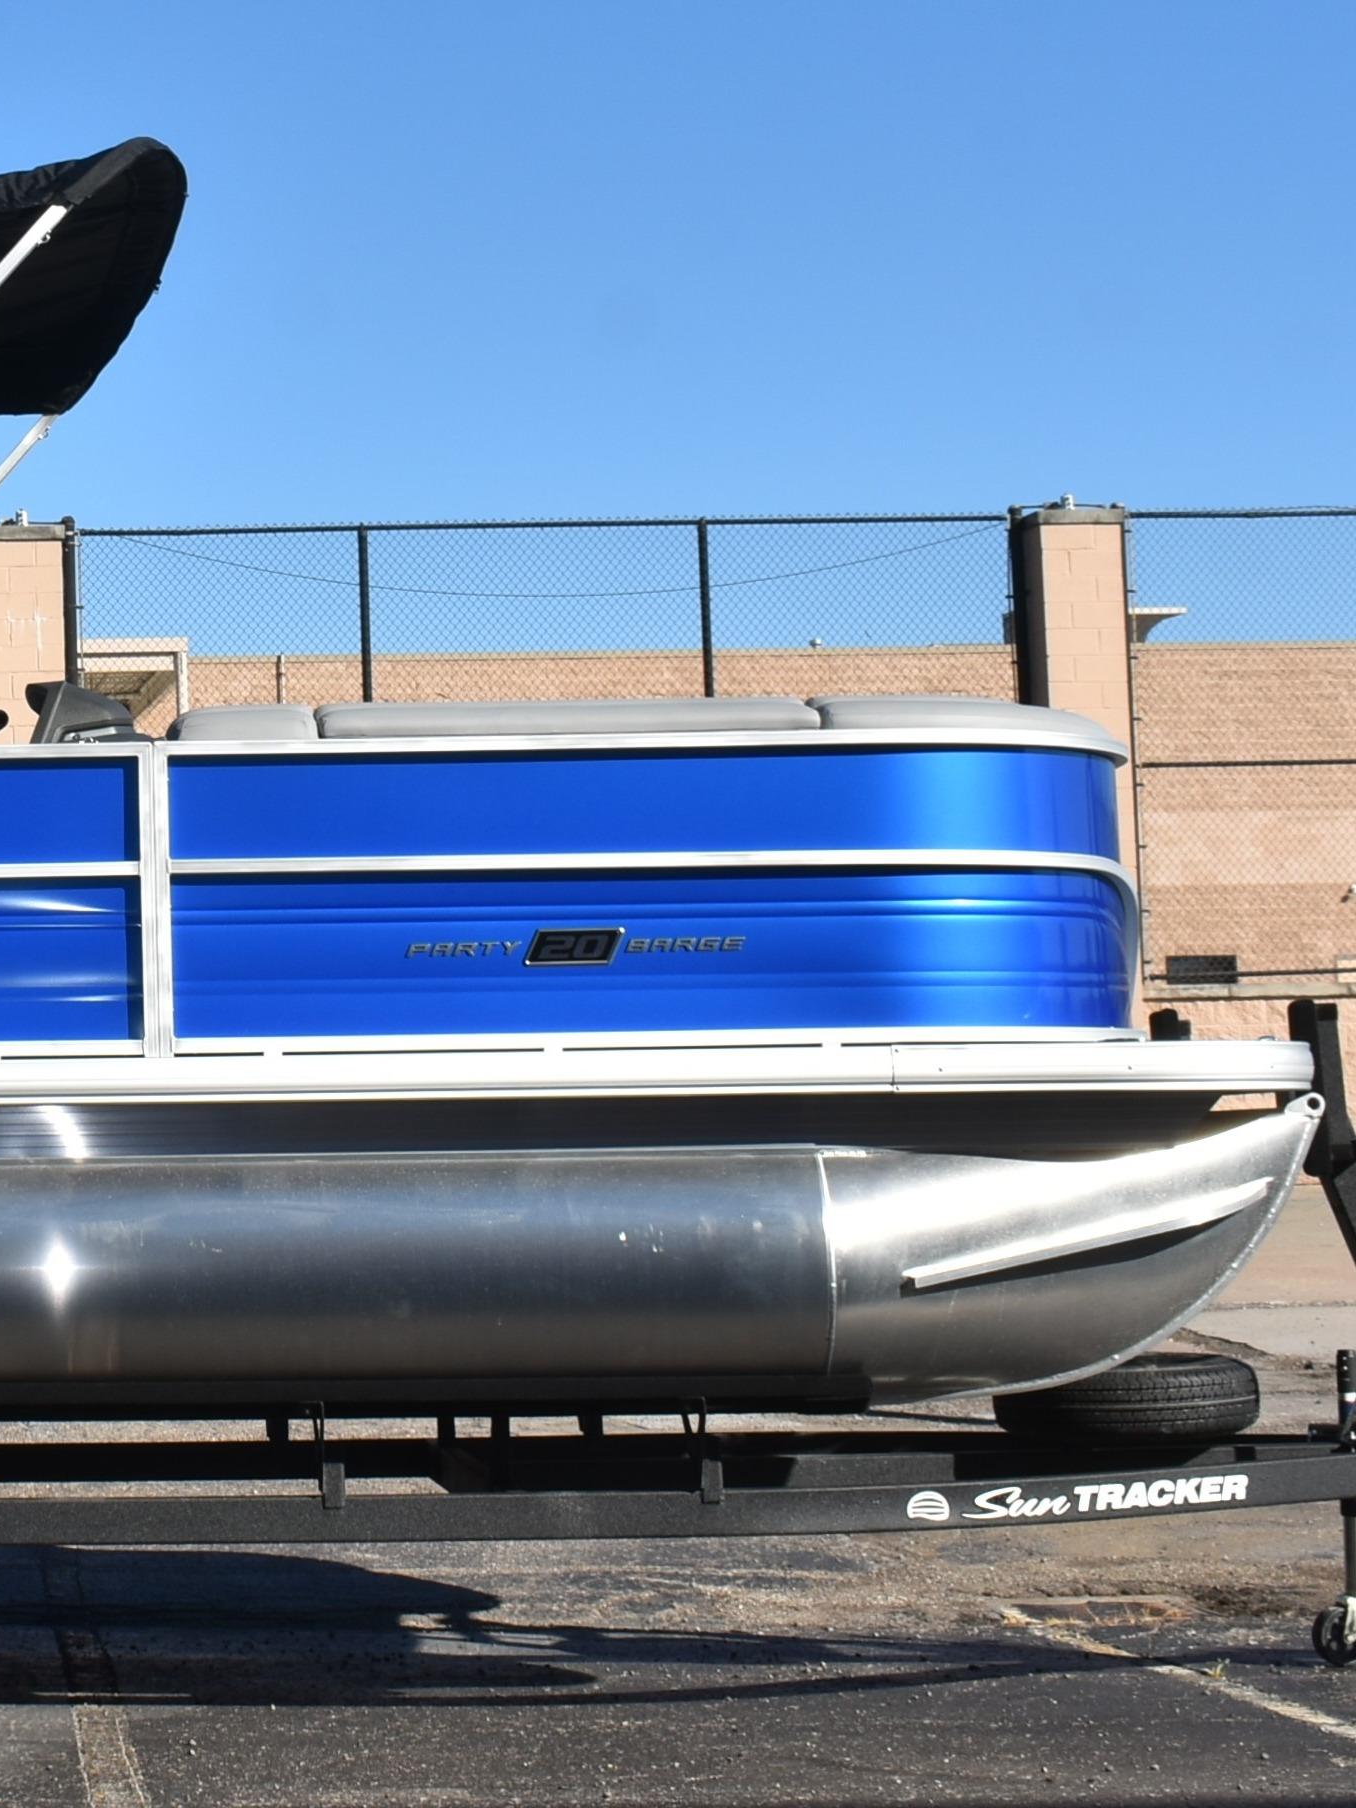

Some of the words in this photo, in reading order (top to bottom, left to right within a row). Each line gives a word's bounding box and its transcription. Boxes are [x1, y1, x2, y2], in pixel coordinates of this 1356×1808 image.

[405, 940, 522, 959] PARTY
[538, 934, 610, 961] 20
[624, 935, 746, 954] BARGE
[961, 1486, 1072, 1519] Sun
[1073, 1474, 1250, 1513] TRACKER
